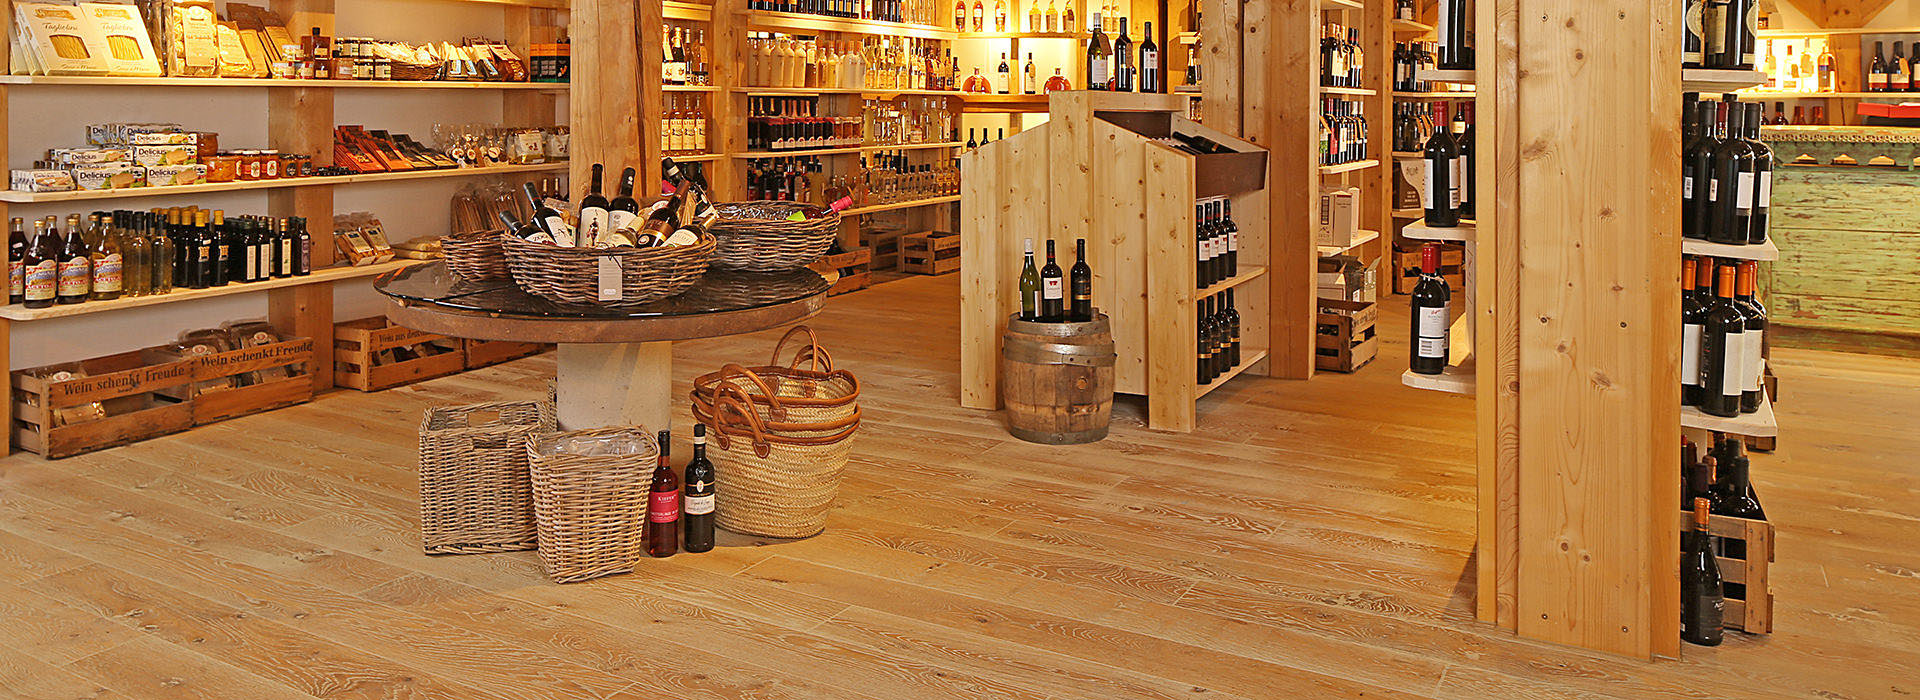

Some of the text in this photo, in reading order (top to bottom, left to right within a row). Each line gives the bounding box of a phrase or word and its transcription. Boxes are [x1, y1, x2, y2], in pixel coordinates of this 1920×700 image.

[138, 148, 167, 156] Delicius
[80, 171, 112, 179] Delicius
[149, 169, 178, 177] Delicius
[200, 355, 227, 367] Wein
[230, 348, 275, 364] schenkt
[276, 342, 312, 357] Freude
[63, 381, 92, 395] Wein
[97, 372, 141, 391] schenkt
[145, 365, 185, 382] Freude
